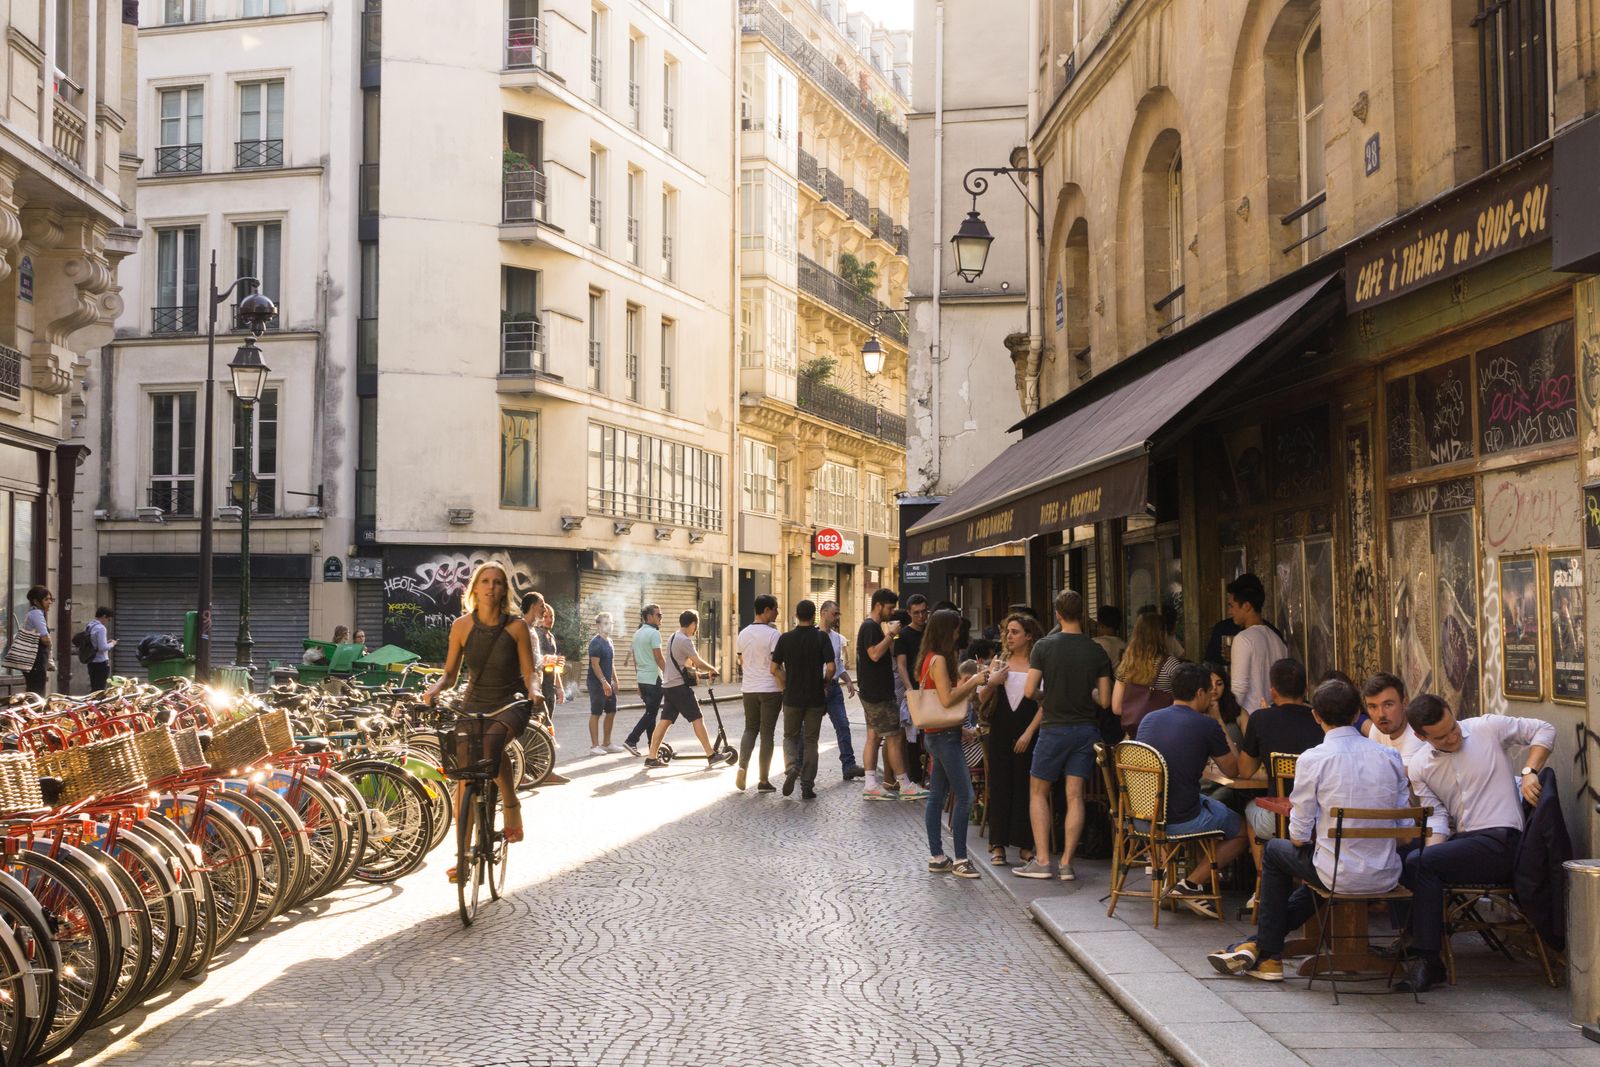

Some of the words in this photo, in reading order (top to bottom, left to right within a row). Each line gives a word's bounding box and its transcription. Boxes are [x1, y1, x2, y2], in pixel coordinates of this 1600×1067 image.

[1365, 142, 1379, 173] 28
[1355, 257, 1385, 303] CAFE
[1453, 229, 1470, 265] au
[1474, 183, 1549, 256] SOUS-SOL
[1070, 487, 1102, 518] COCKTAILS
